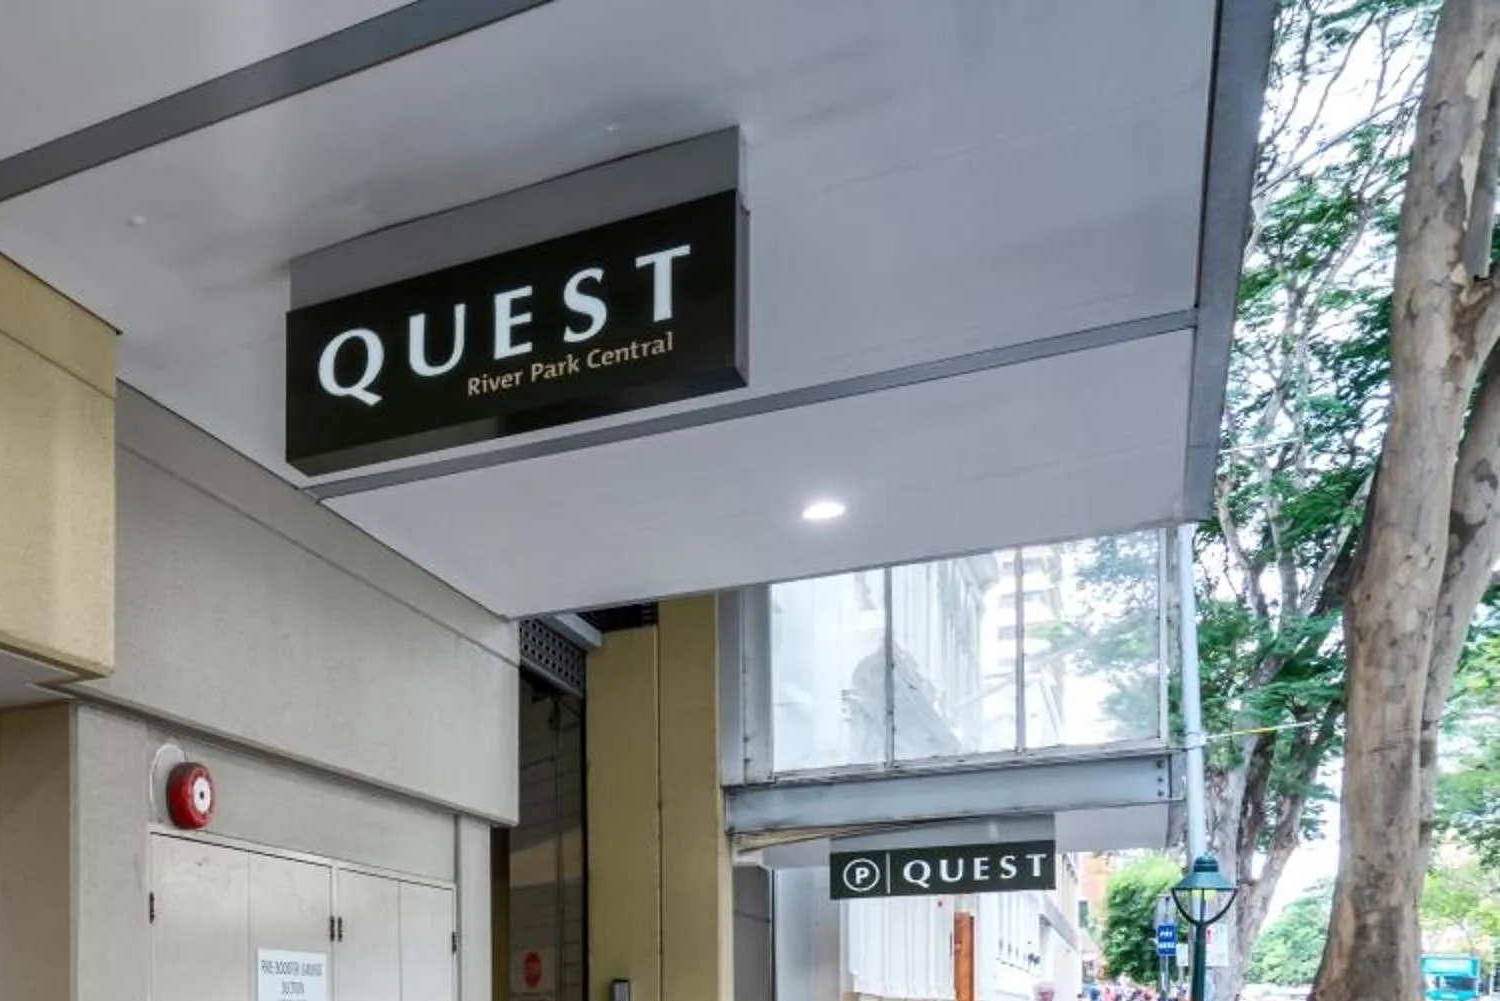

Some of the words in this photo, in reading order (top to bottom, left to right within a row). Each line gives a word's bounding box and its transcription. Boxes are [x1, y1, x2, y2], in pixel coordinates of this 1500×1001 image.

[317, 244, 691, 407] QUEST
[467, 370, 523, 396] River
[530, 353, 580, 382] Park
[587, 331, 674, 368] Central
[903, 853, 1047, 888] QUEST
